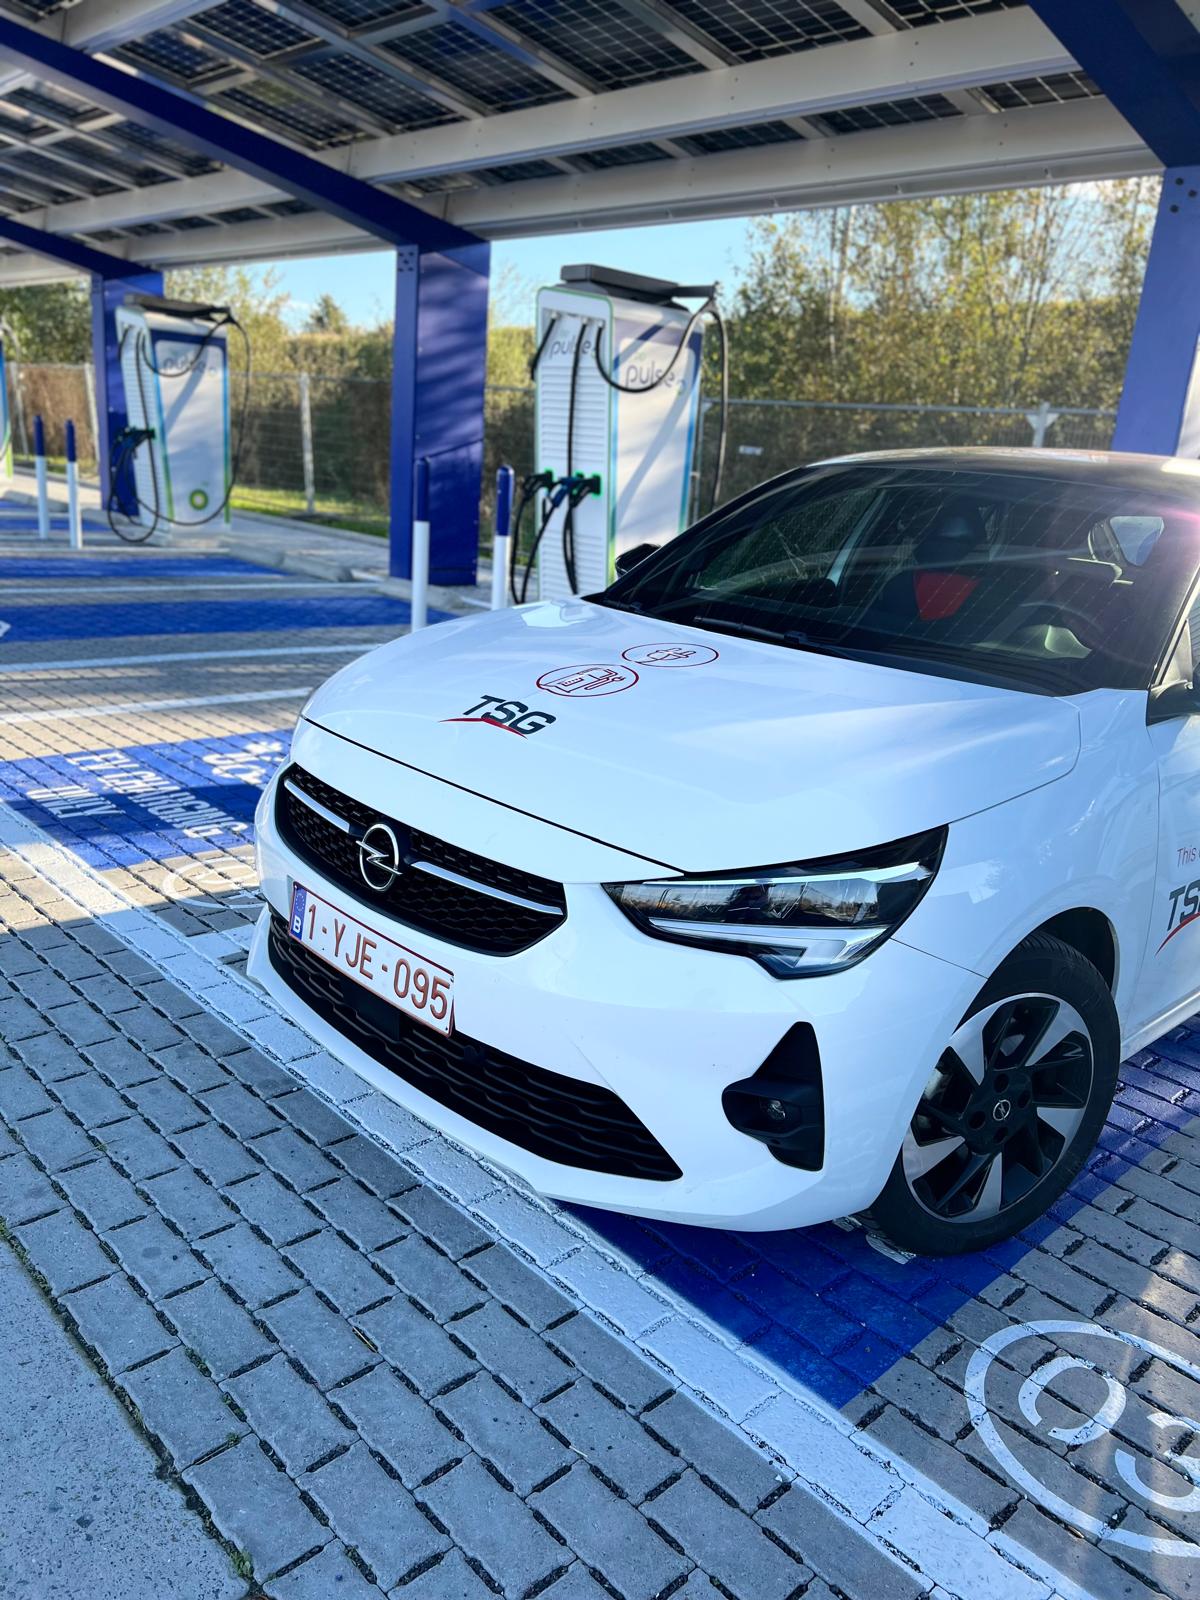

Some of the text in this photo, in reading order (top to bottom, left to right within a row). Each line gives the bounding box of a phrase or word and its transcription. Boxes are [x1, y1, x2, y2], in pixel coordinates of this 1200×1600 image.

[462, 695, 557, 735] TSG
[26, 785, 126, 819] ONLY
[66, 751, 248, 838] EV CHARGING
[1177, 845, 1197, 868] This
[1167, 879, 1200, 931] TS
[292, 917, 302, 934] B
[308, 904, 450, 1020] 1-YJE-095
